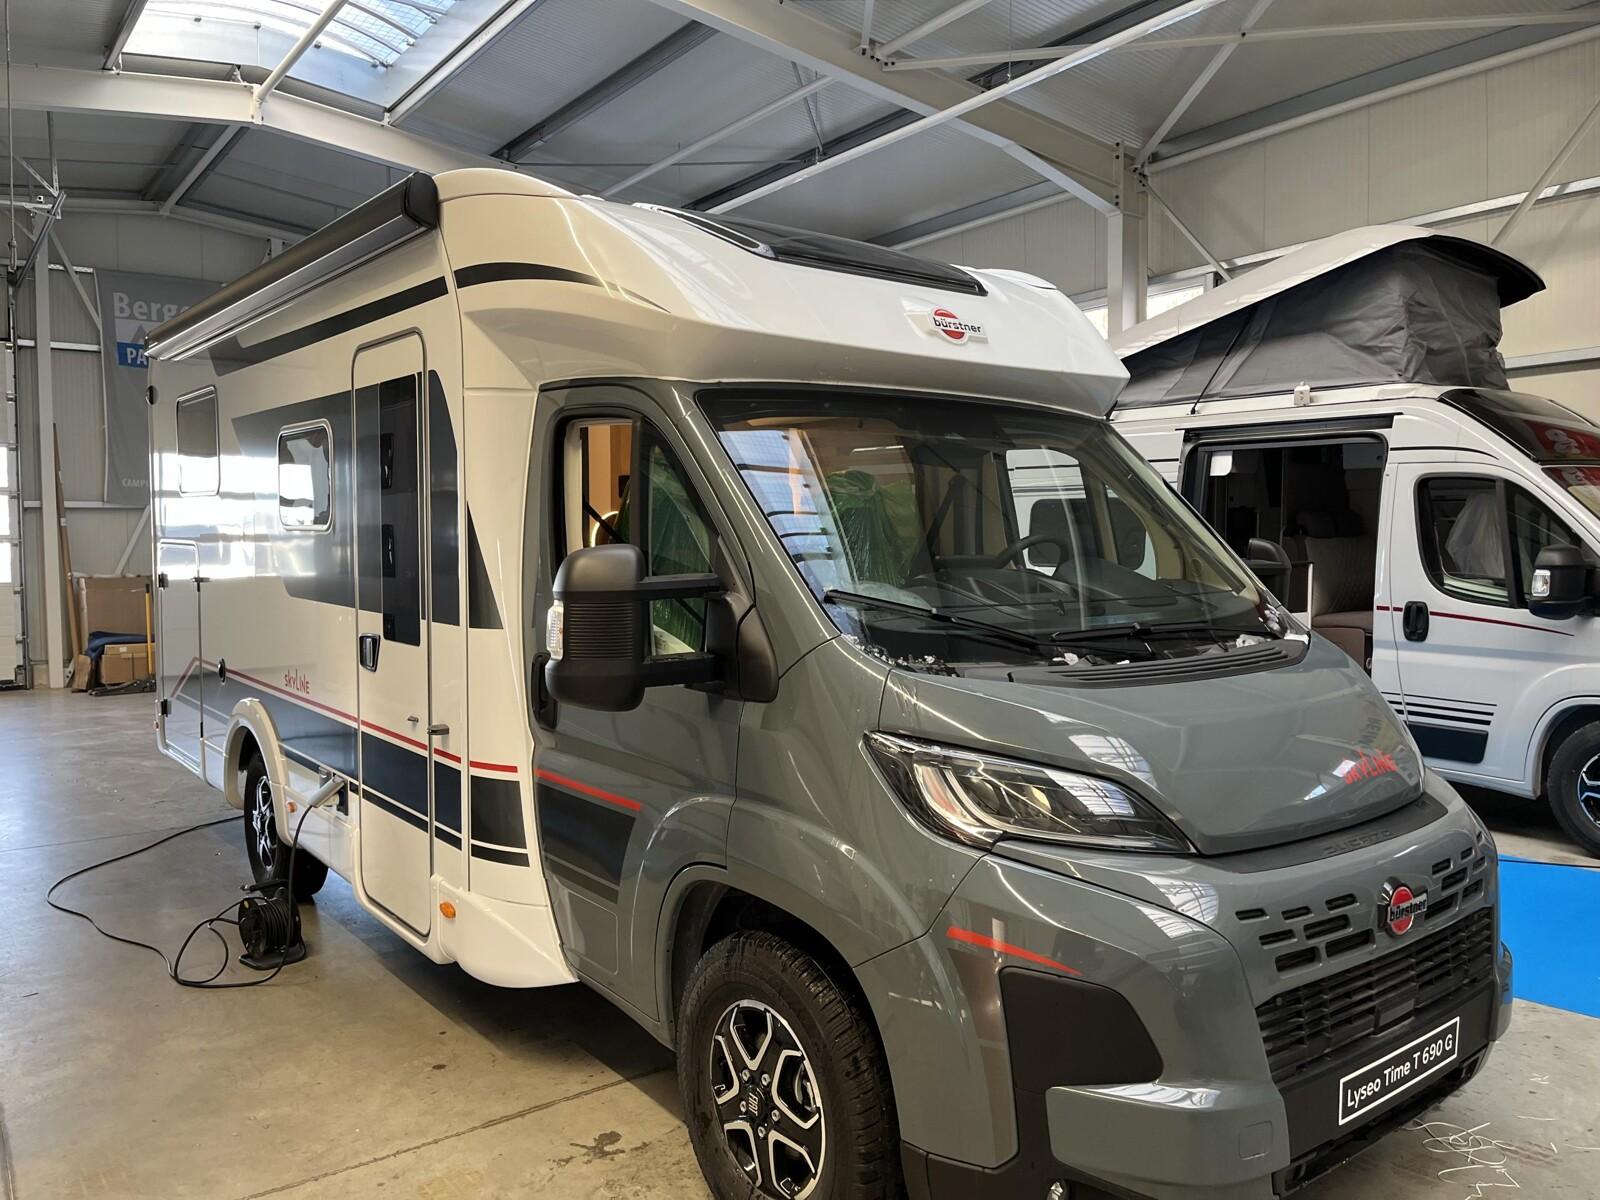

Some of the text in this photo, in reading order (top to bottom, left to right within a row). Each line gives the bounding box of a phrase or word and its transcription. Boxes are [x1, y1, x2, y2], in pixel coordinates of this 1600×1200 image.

[933, 317, 981, 333] bürstner
[1347, 1033, 1453, 1108] Lyseo Time T 690 G
